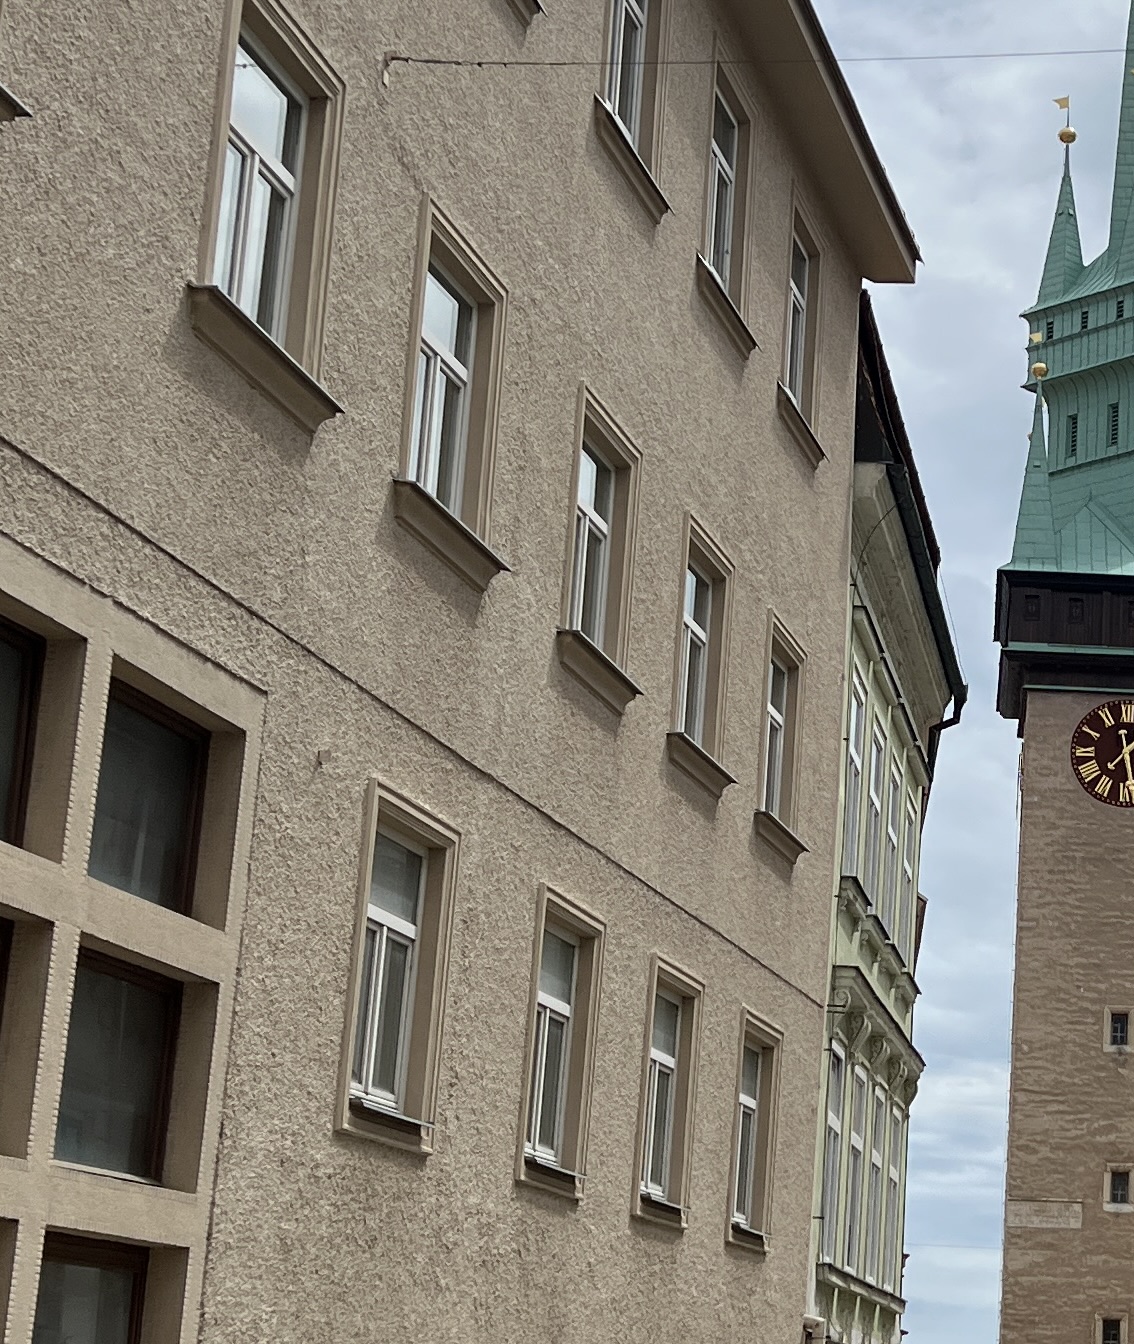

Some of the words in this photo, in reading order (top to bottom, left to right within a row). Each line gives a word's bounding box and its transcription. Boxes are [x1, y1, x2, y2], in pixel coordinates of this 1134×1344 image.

[1098, 707, 1115, 728] XI
[1120, 704, 1134, 723] XII
[1082, 725, 1100, 741] X
